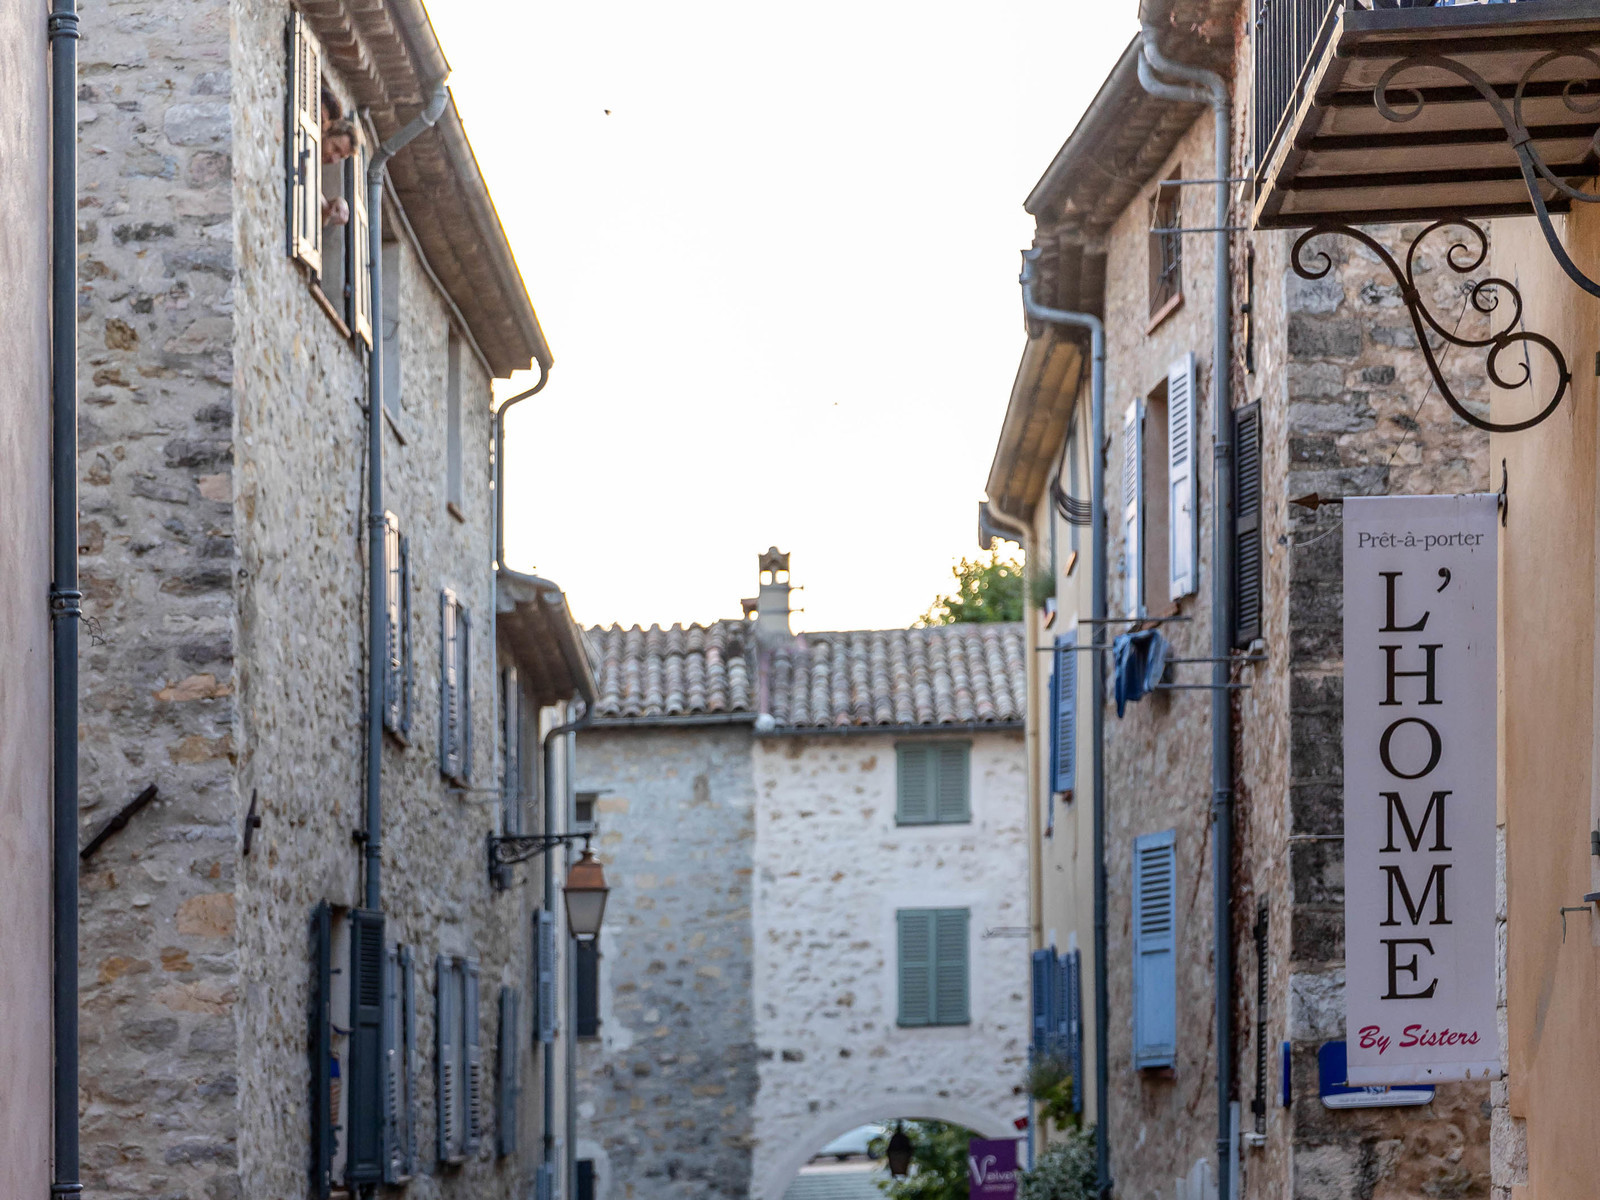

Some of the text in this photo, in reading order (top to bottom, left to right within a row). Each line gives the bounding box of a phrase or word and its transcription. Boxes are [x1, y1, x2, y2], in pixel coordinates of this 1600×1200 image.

[1358, 531, 1485, 552] Prêt-à-porter
[1358, 1024, 1481, 1055] By Sisters
